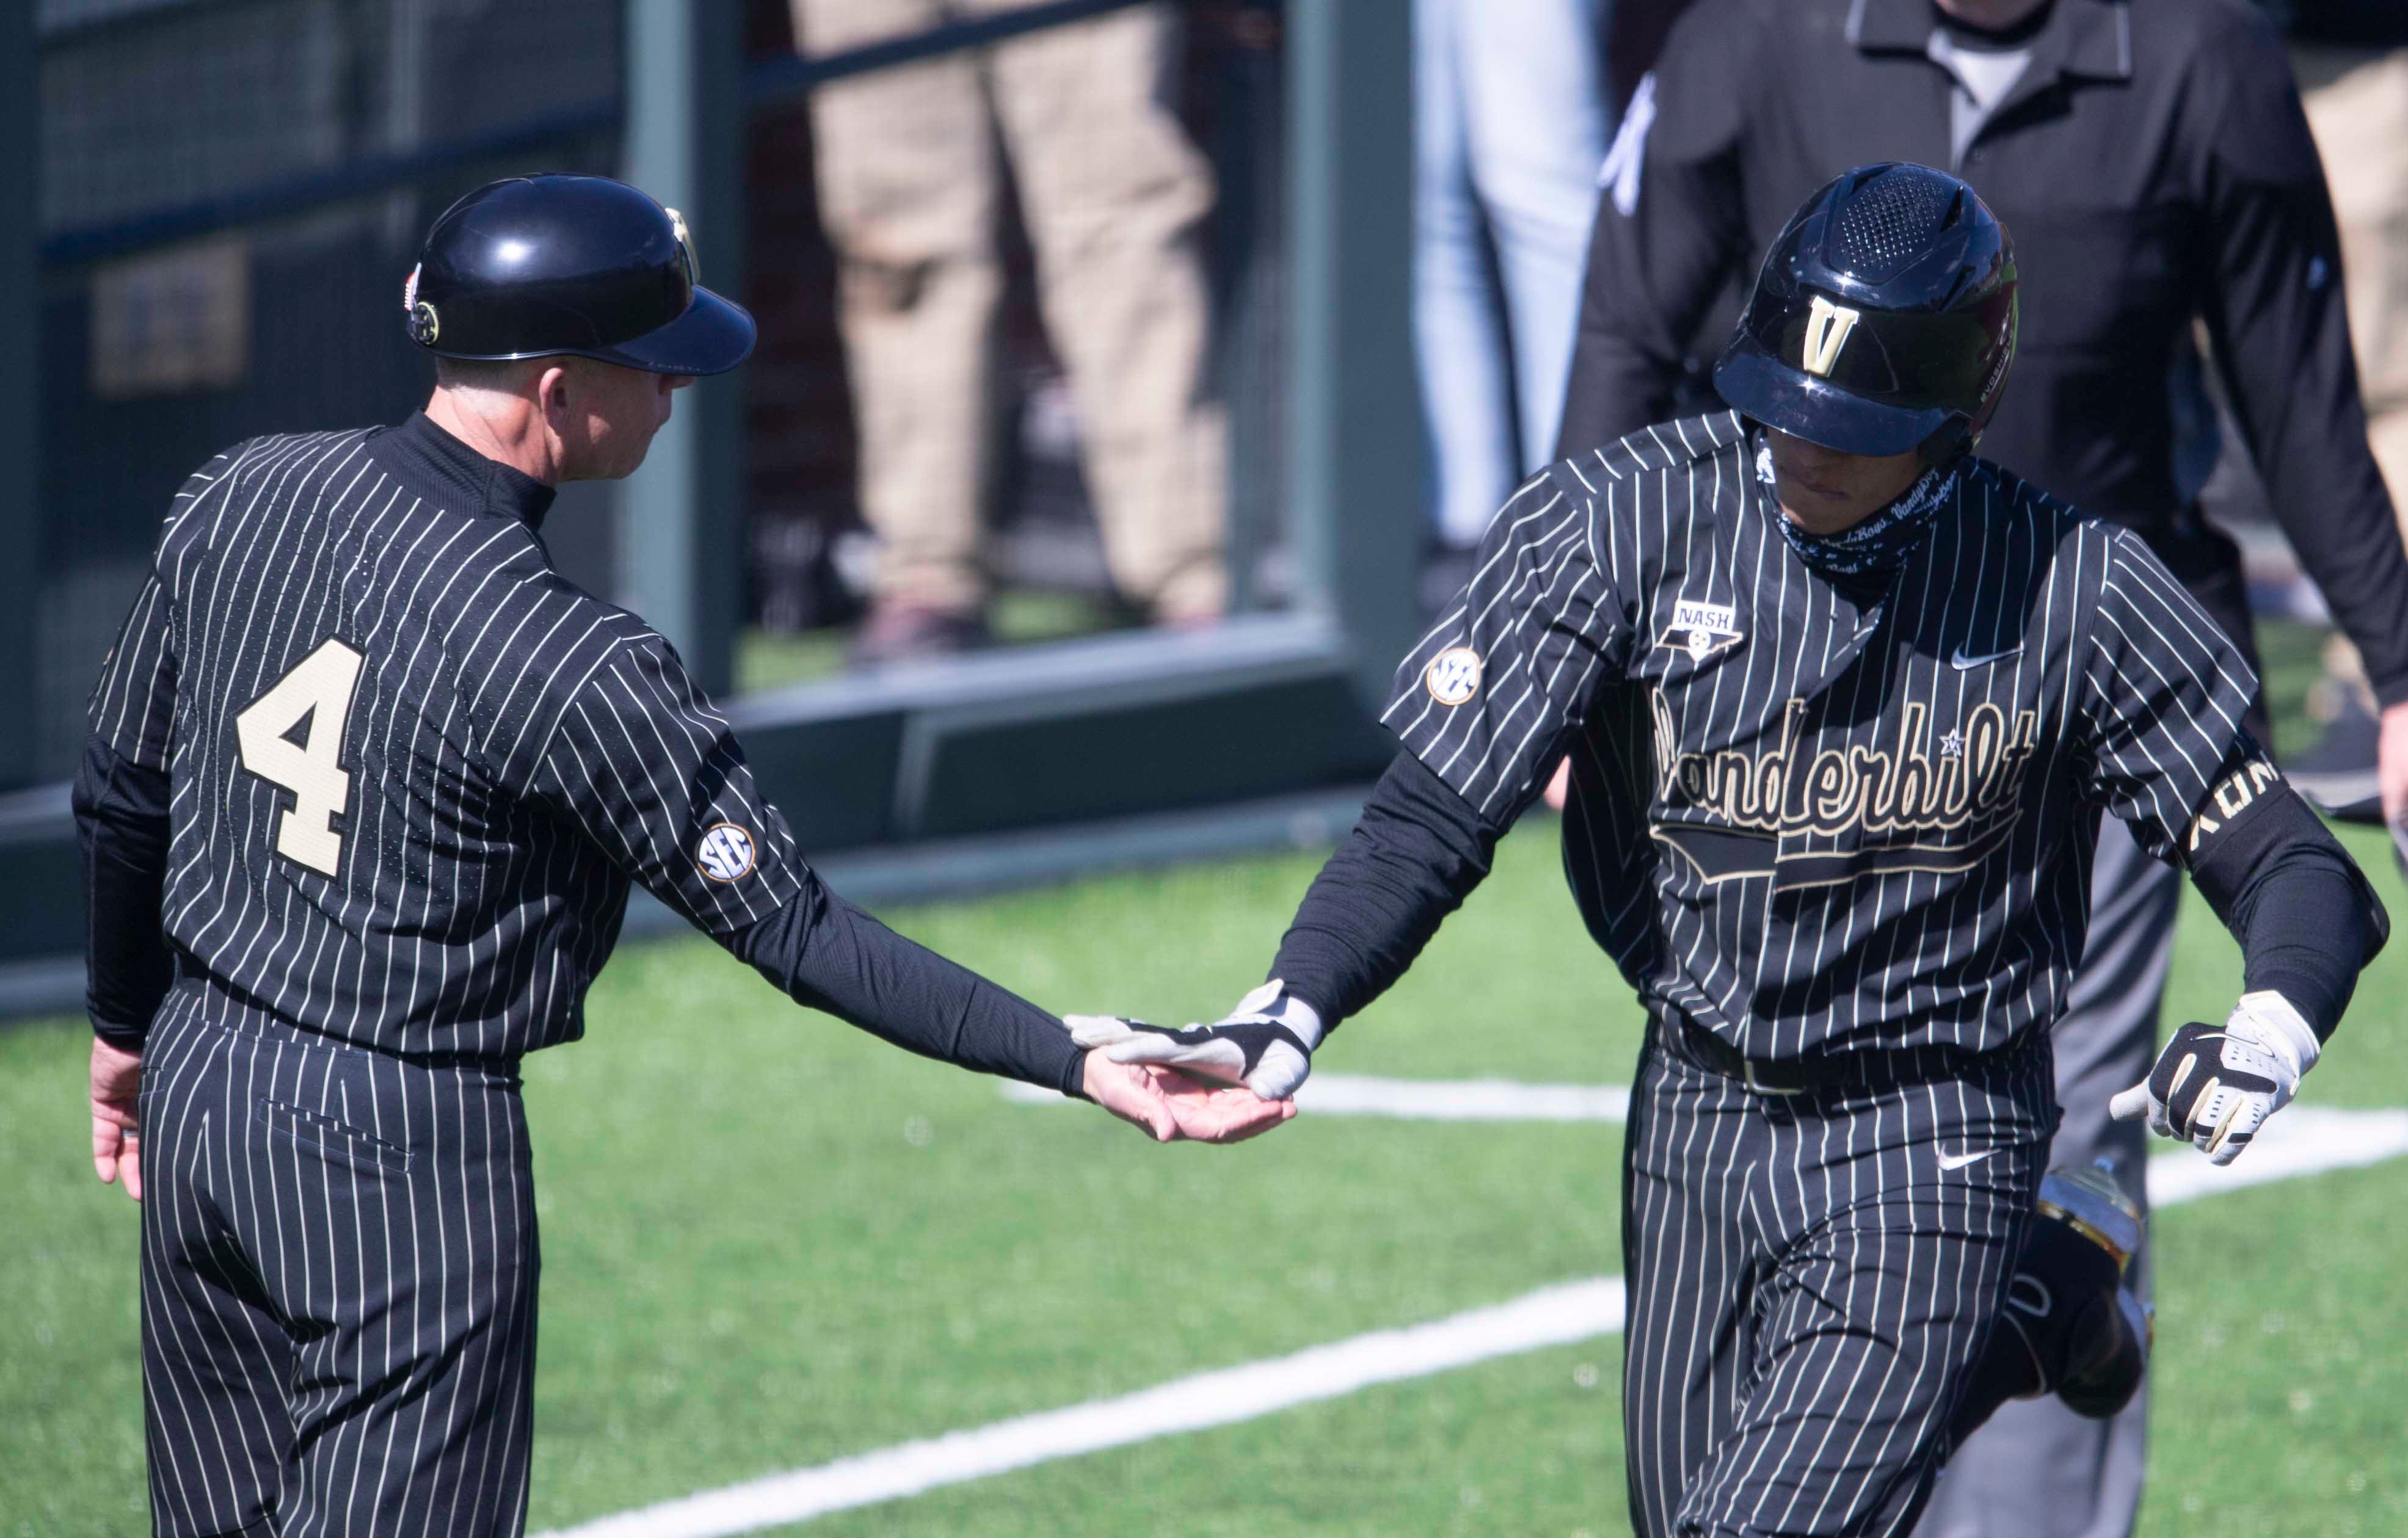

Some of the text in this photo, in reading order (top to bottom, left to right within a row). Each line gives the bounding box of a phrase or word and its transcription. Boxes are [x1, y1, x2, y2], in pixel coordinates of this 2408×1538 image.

[1803, 295, 1860, 377] V
[1678, 608, 1730, 629] NASH
[1430, 651, 1478, 702] SEC
[235, 636, 363, 880] 4
[699, 827, 752, 879] SEC
